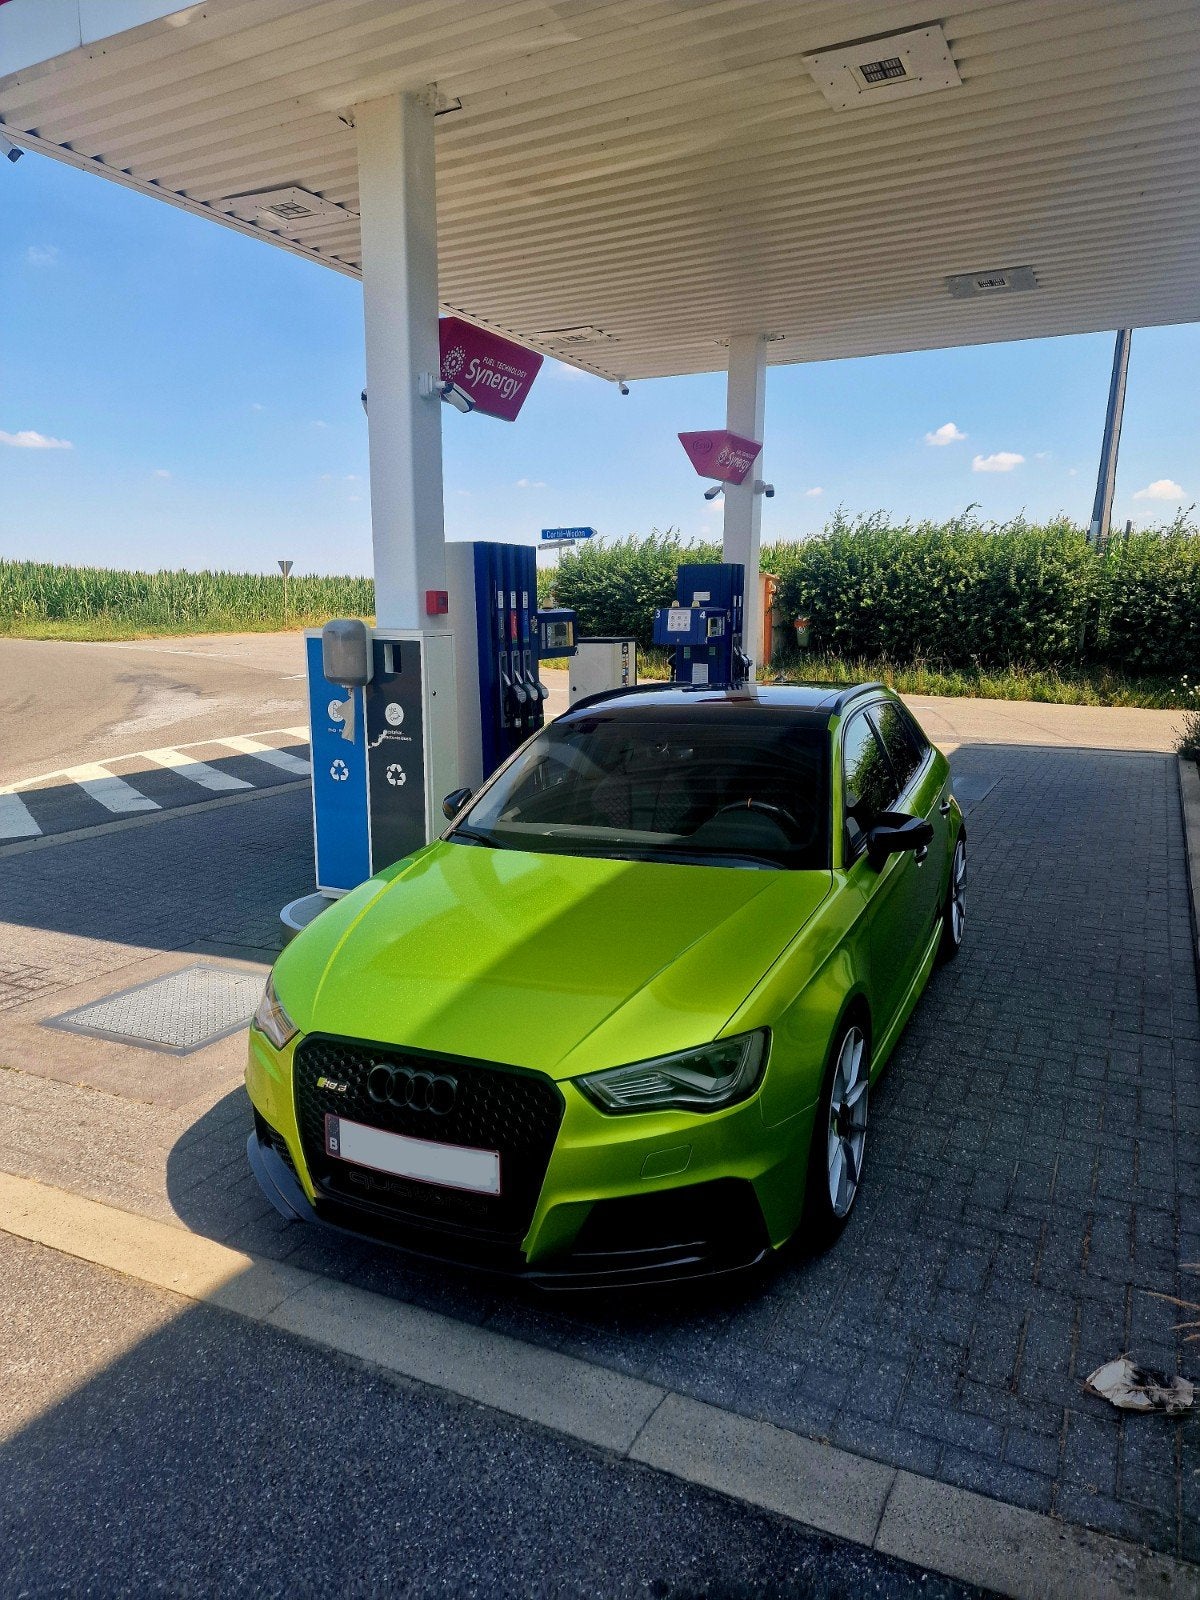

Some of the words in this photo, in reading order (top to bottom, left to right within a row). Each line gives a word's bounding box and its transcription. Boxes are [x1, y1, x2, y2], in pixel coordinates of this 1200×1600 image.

[483, 356, 495, 367] FUEL
[496, 361, 528, 379] TECHNOLOGY
[465, 358, 523, 400] Synergy
[655, 609, 661, 619] 3
[699, 610, 706, 620] 4
[329, 1137, 339, 1151] B
